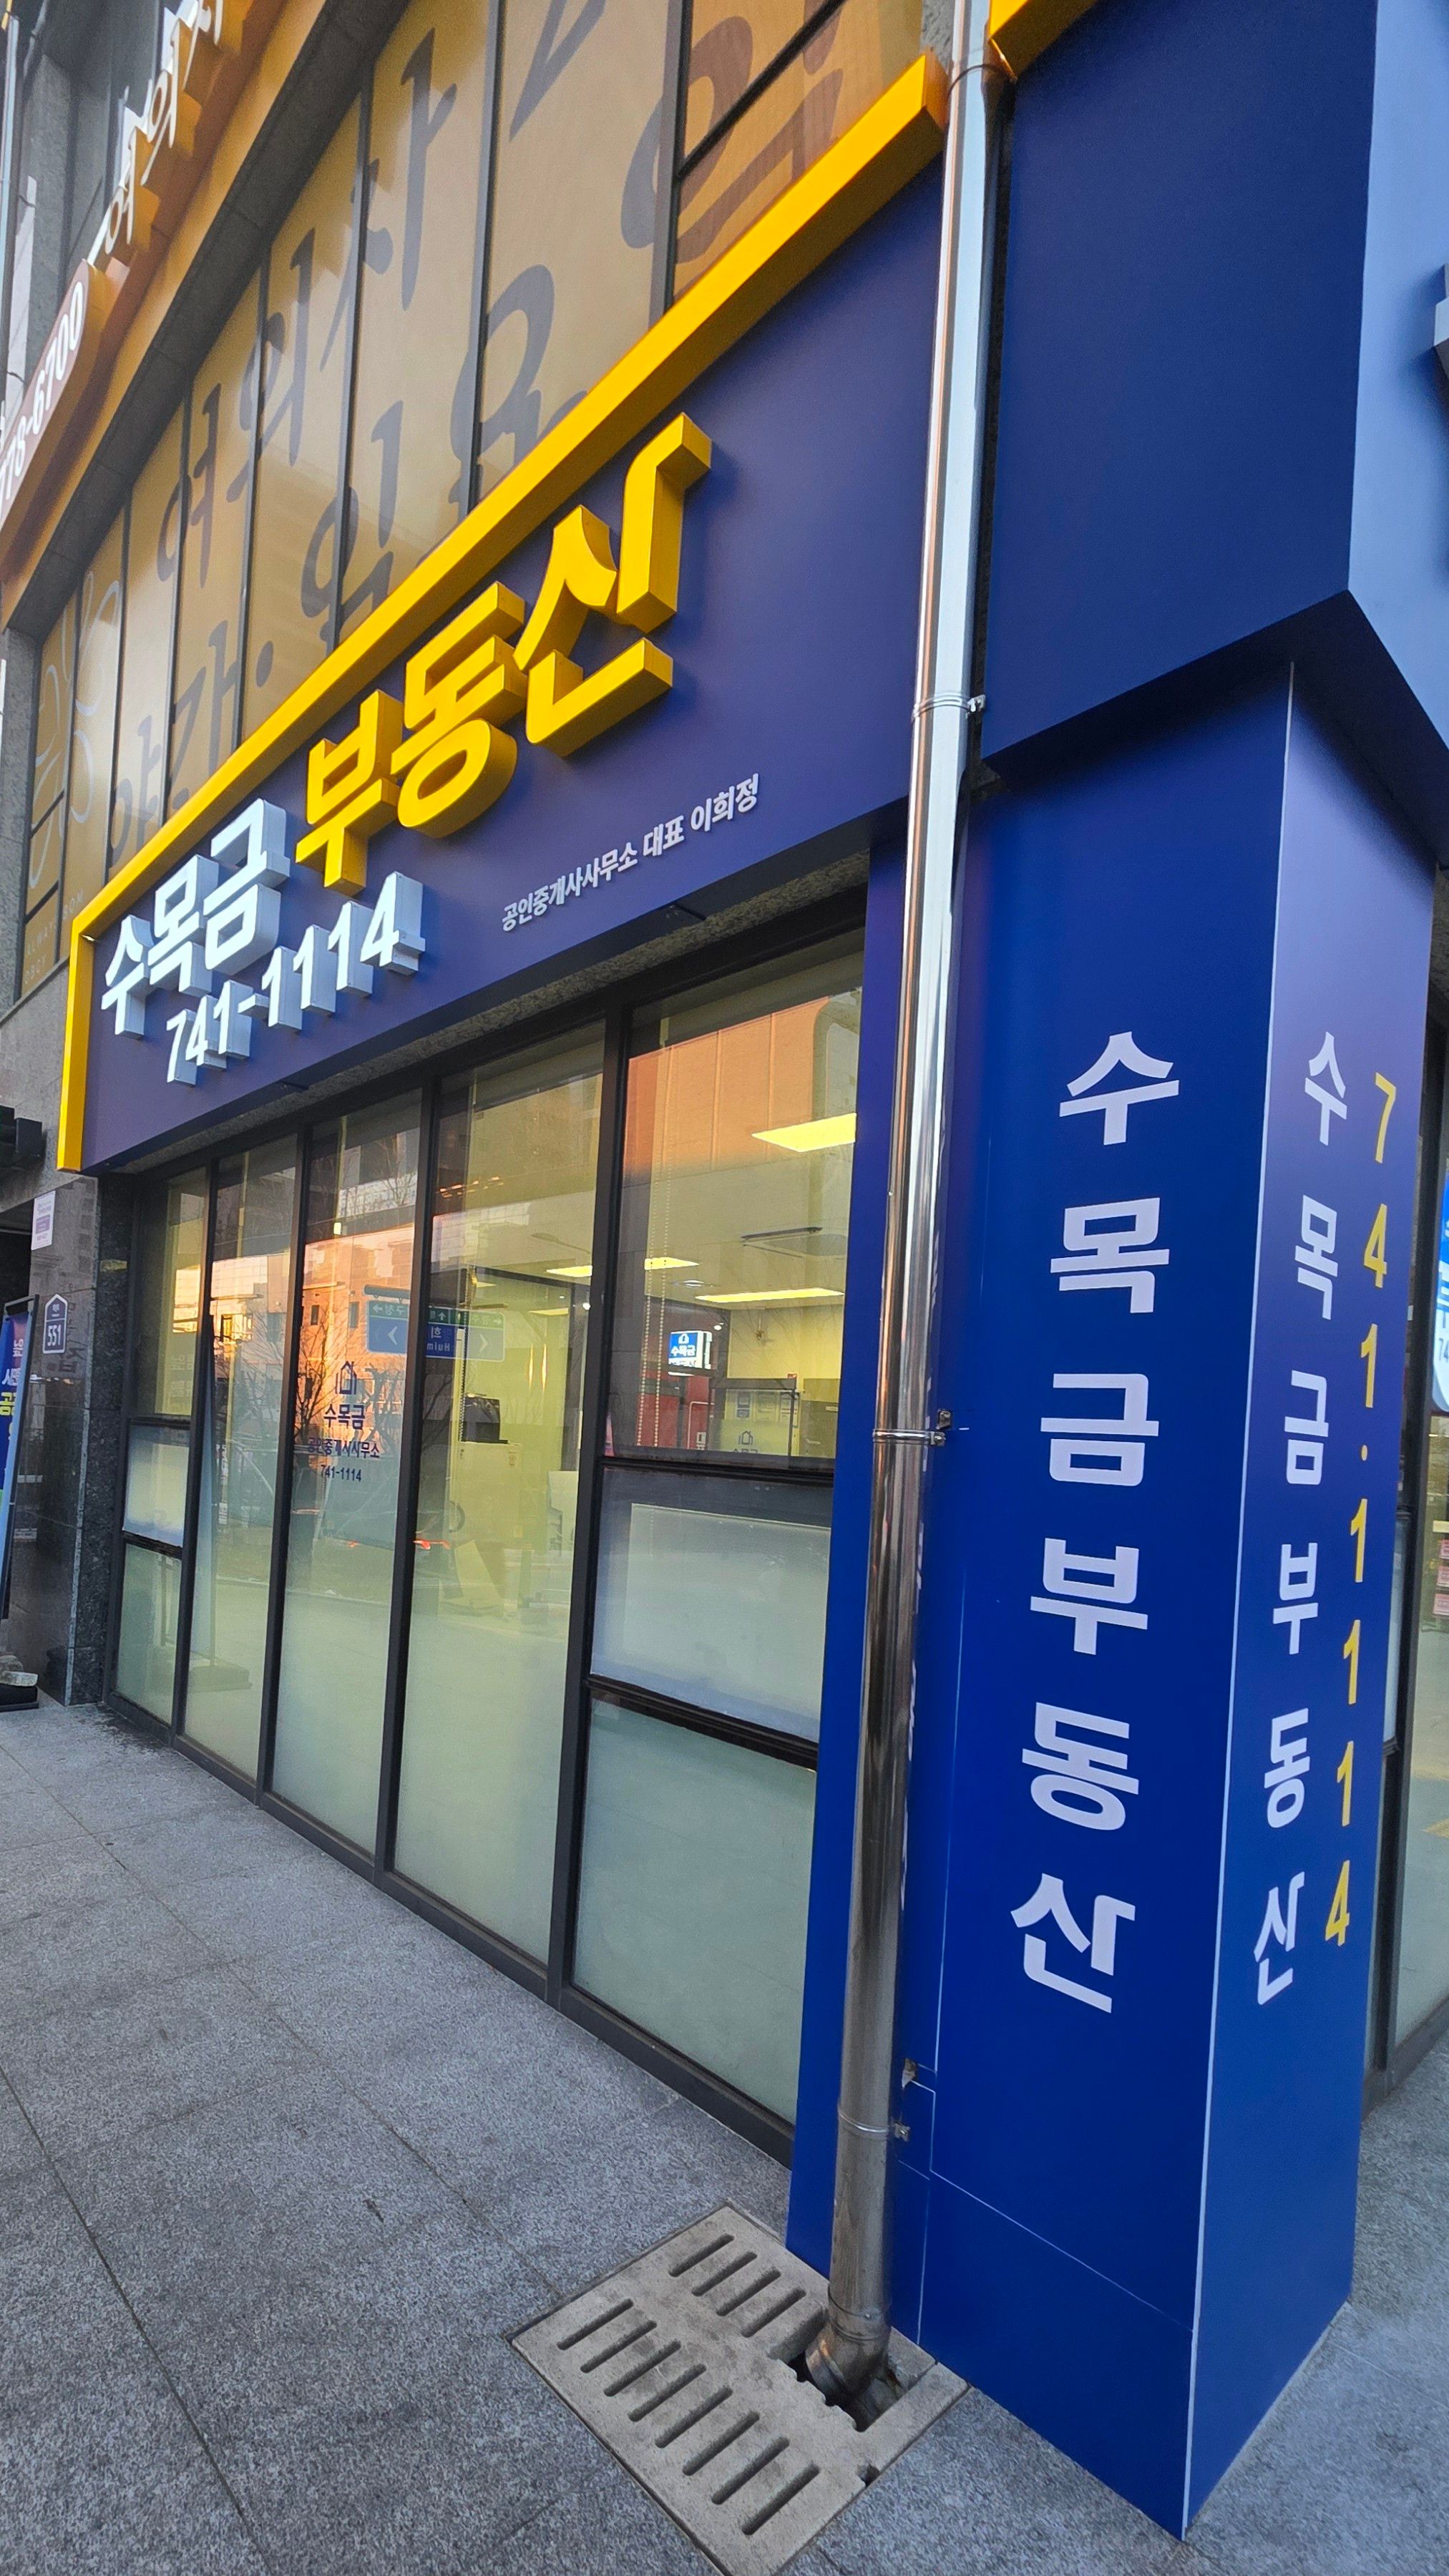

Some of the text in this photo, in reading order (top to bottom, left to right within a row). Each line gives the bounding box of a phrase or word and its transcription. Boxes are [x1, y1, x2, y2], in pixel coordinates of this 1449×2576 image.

[102, 412, 708, 1038] 수목금 부동산
[502, 773, 760, 932] 공인중개사사무소 대표 이희정
[167, 871, 424, 1086] 741-1114
[47, 1323, 62, 1347] 551
[323, 1403, 366, 1430] 수목금
[320, 1464, 362, 1482] 741-1114
[1010, 1031, 1180, 2014] 수목금부동산
[1254, 1031, 1348, 2005] 수목금부동산
